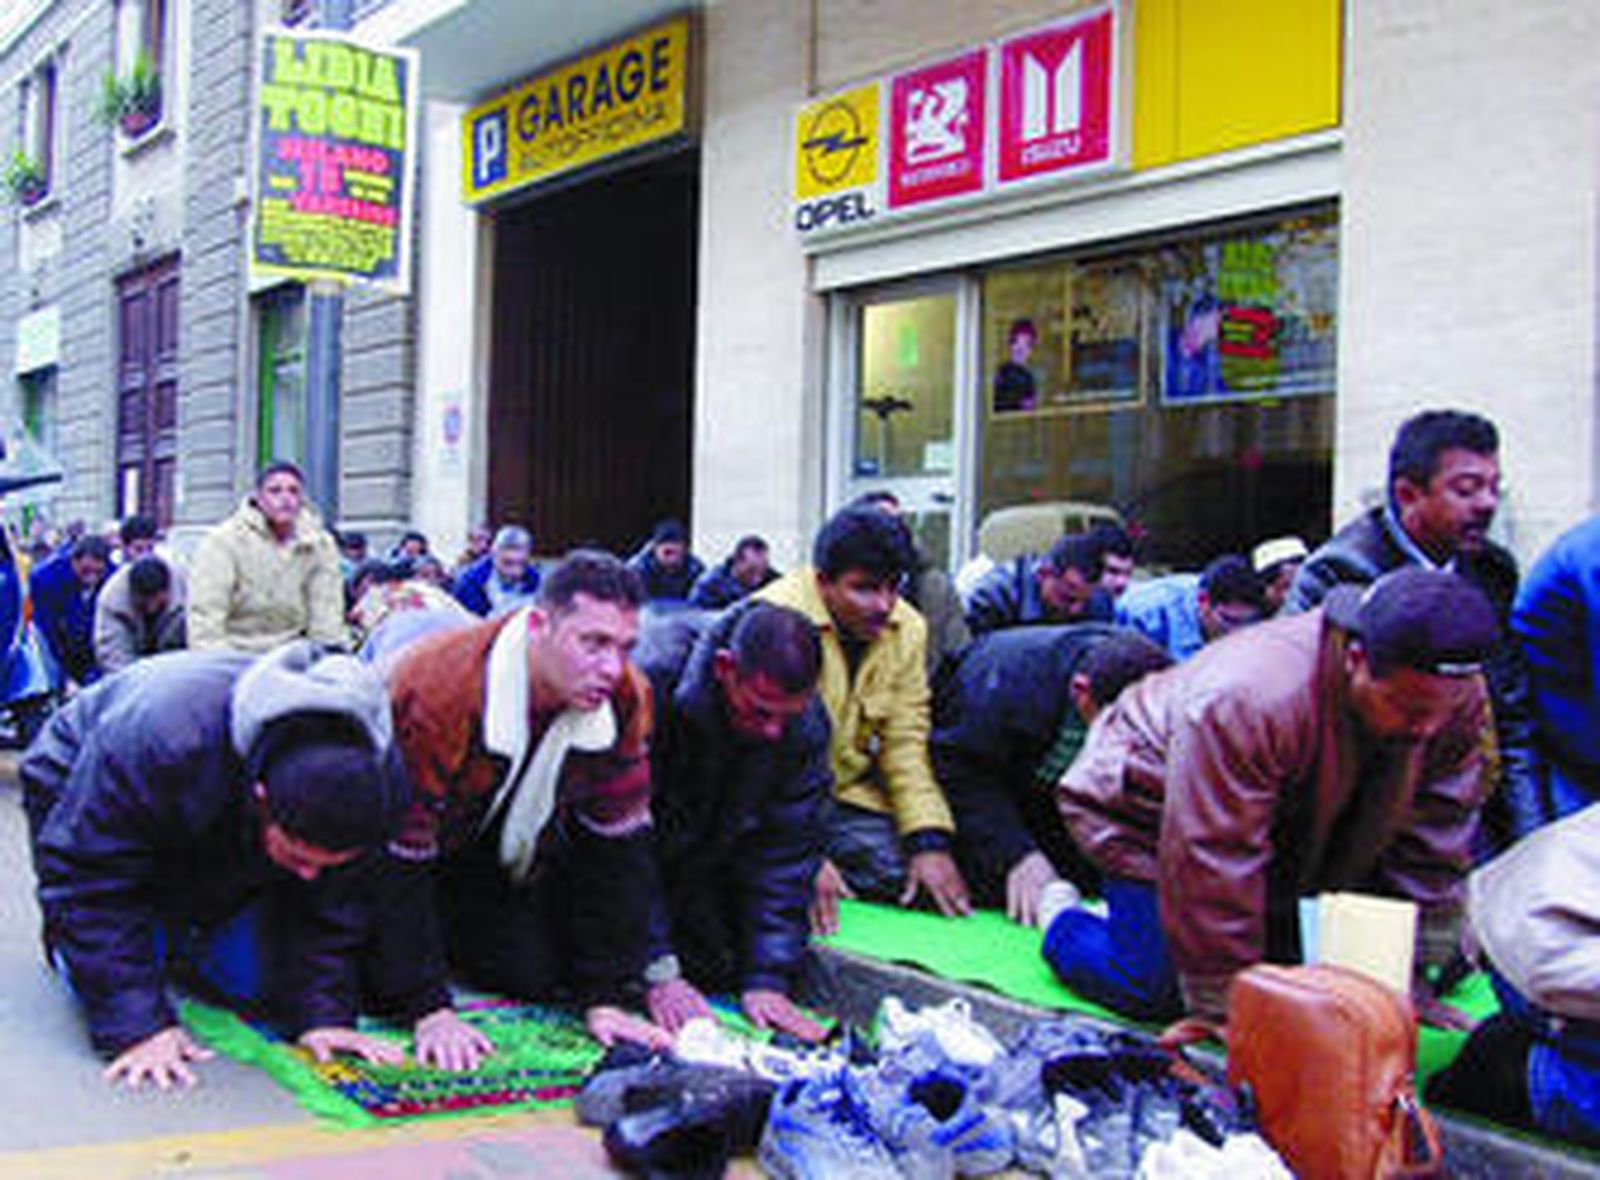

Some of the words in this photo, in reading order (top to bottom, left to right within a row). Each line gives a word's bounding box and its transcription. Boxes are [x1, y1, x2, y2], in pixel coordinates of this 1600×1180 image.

[516, 37, 671, 142] GARAGE
[480, 115, 501, 181] P
[795, 193, 875, 231] OPEL
